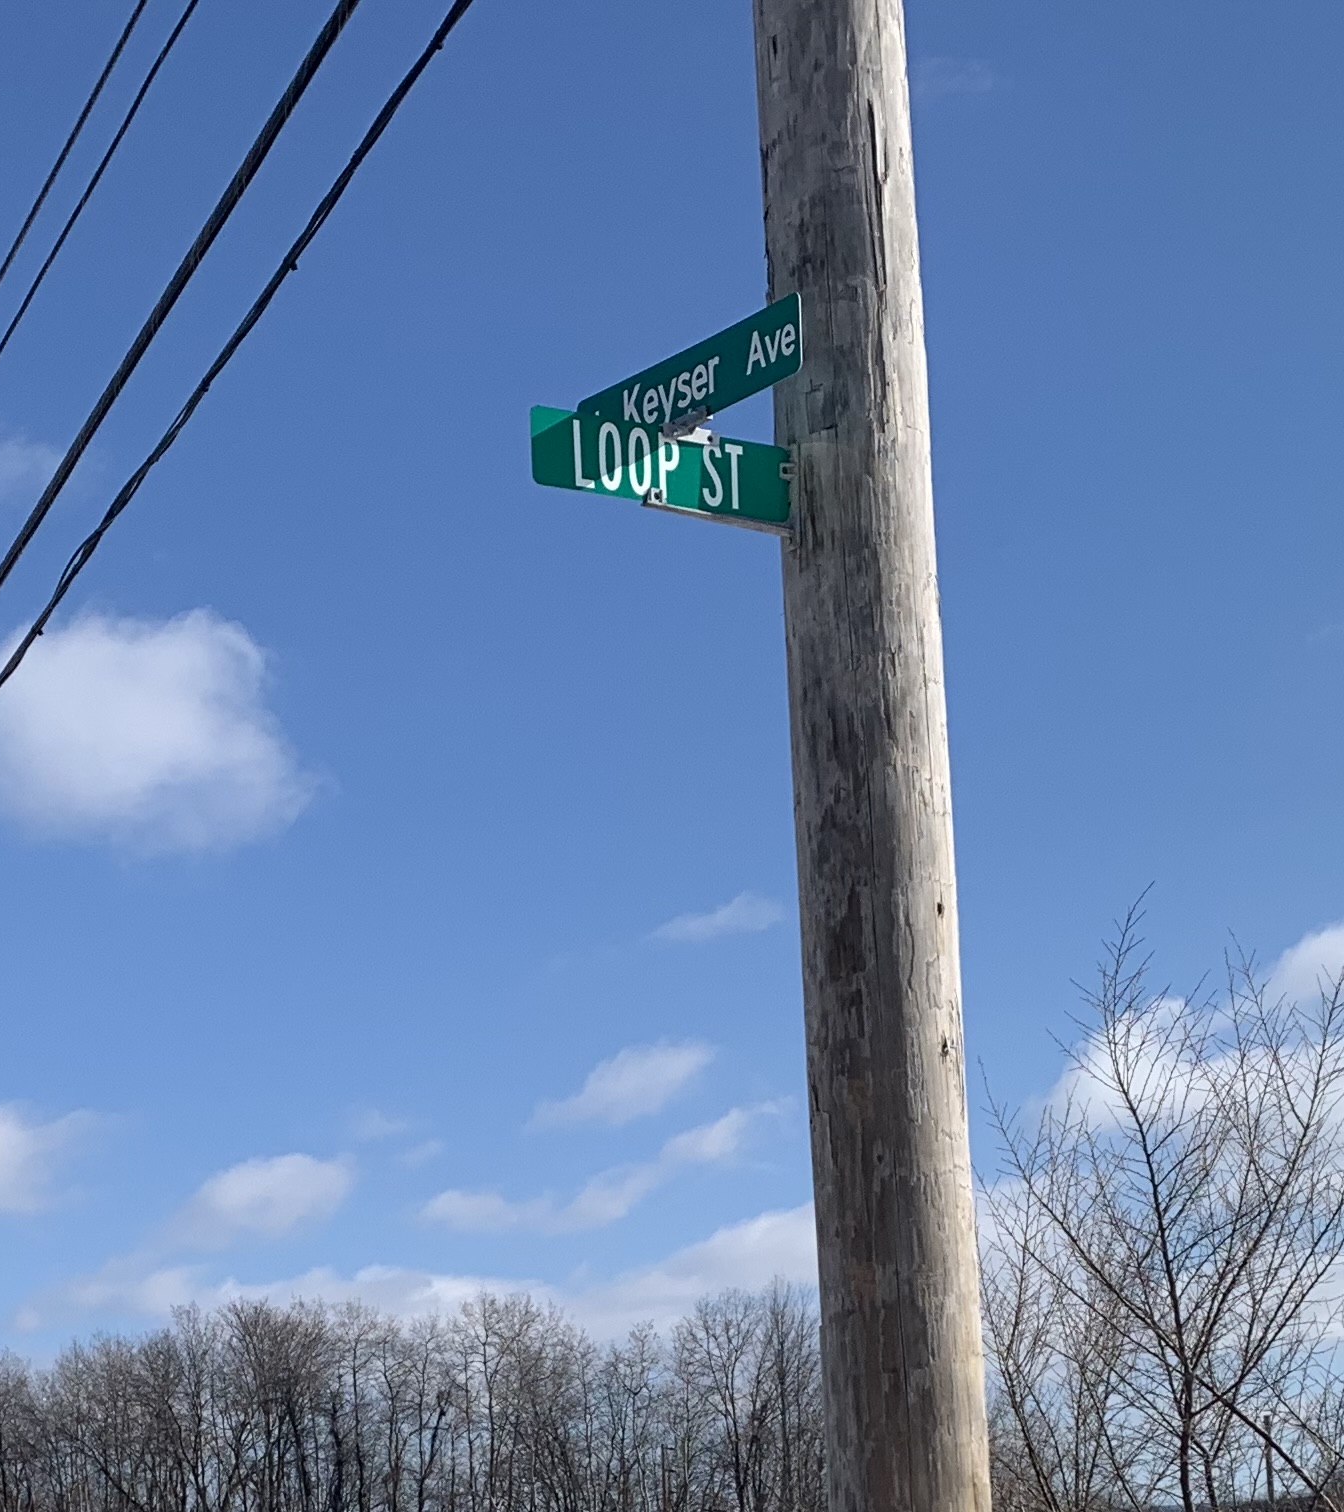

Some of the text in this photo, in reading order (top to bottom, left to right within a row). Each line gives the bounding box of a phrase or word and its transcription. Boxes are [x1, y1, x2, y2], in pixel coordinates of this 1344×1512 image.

[622, 322, 796, 425] Keyser Ave
[572, 419, 744, 510] LOOP ST
